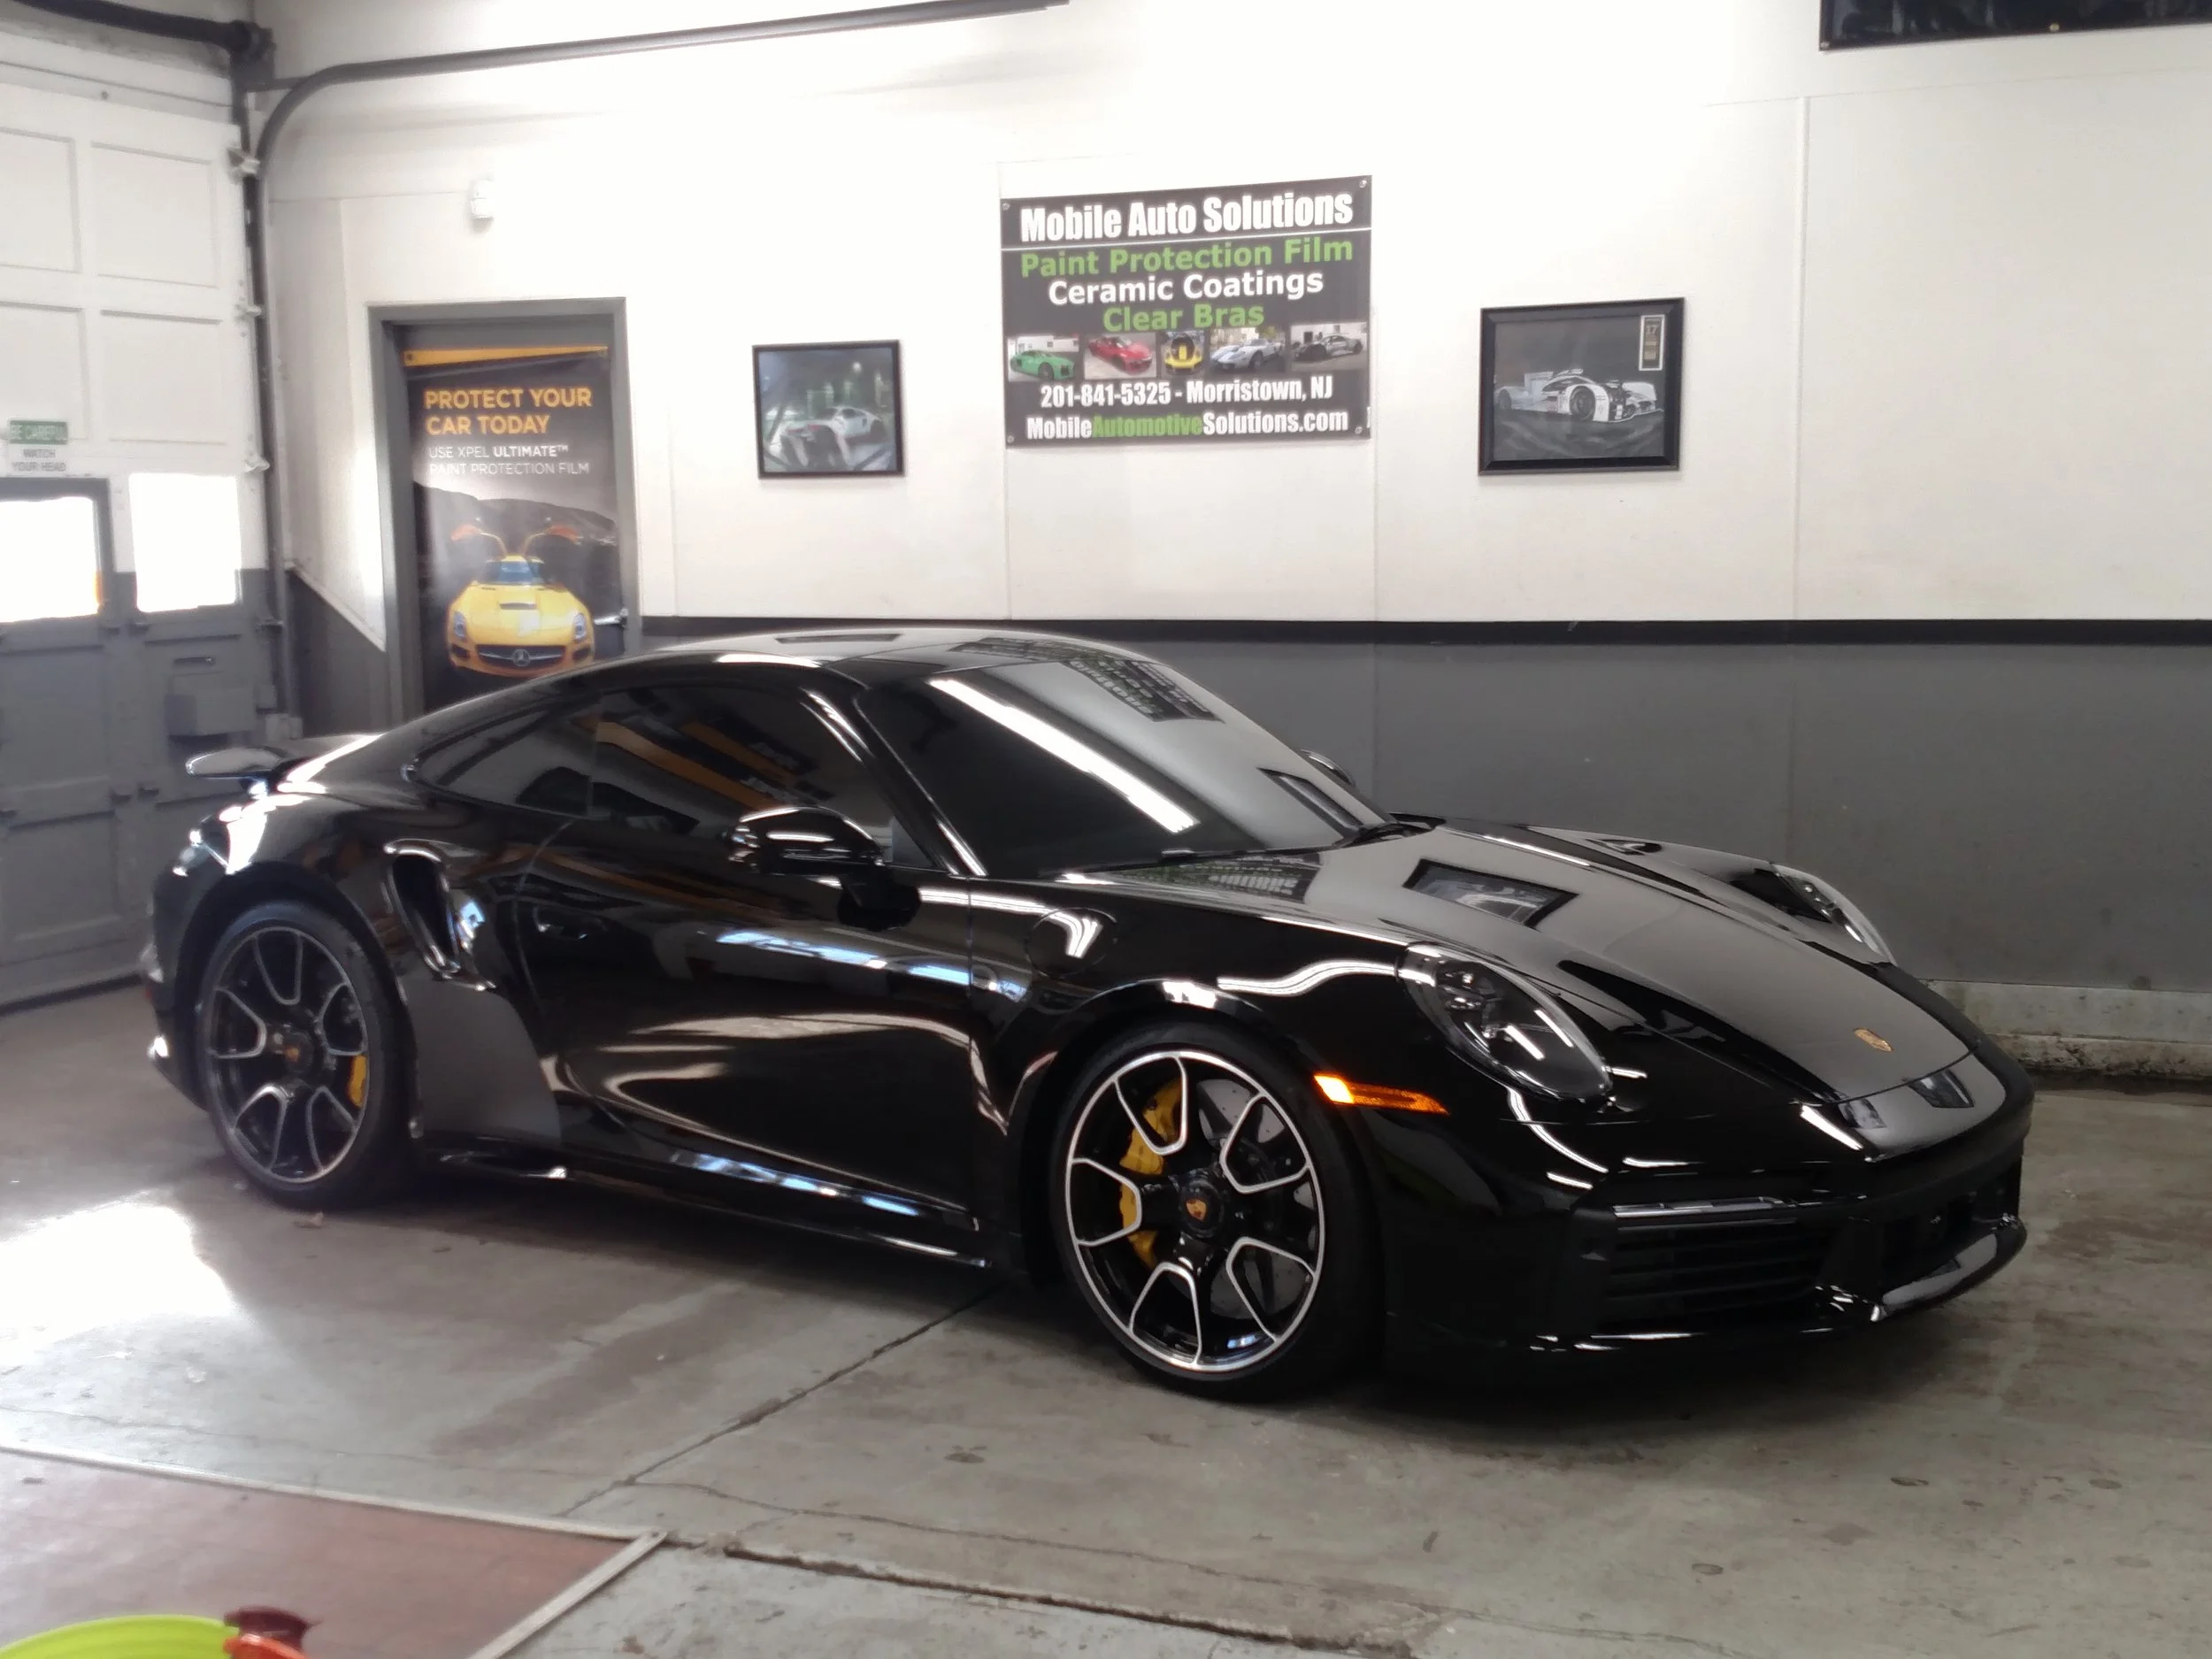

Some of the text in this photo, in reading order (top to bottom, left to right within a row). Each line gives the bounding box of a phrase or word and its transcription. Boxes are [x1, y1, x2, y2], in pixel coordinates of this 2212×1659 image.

[1020, 191, 1353, 242] Mobile Auto Solutions
[1021, 236, 1353, 278] Paint Protection Film
[1048, 271, 1325, 305] Ceramic Coatings
[1103, 303, 1265, 332] Clear Bras
[425, 387, 592, 410] PROTECT YOUR
[1041, 381, 1171, 408] 201-841-5325
[1187, 377, 1307, 404] Morristown,
[1310, 376, 1333, 400] NJ
[11, 425, 22, 440] BE
[426, 414, 549, 435] CAR TODAY
[1026, 411, 1348, 440] MobileAutomotiveSolutions.com
[23, 449, 56, 458] WATCH
[429, 446, 454, 458] USE
[457, 446, 489, 458] XPEL
[12, 461, 66, 472] YOUR HEAD
[429, 462, 590, 475] PAINT PROTECTION FILM
